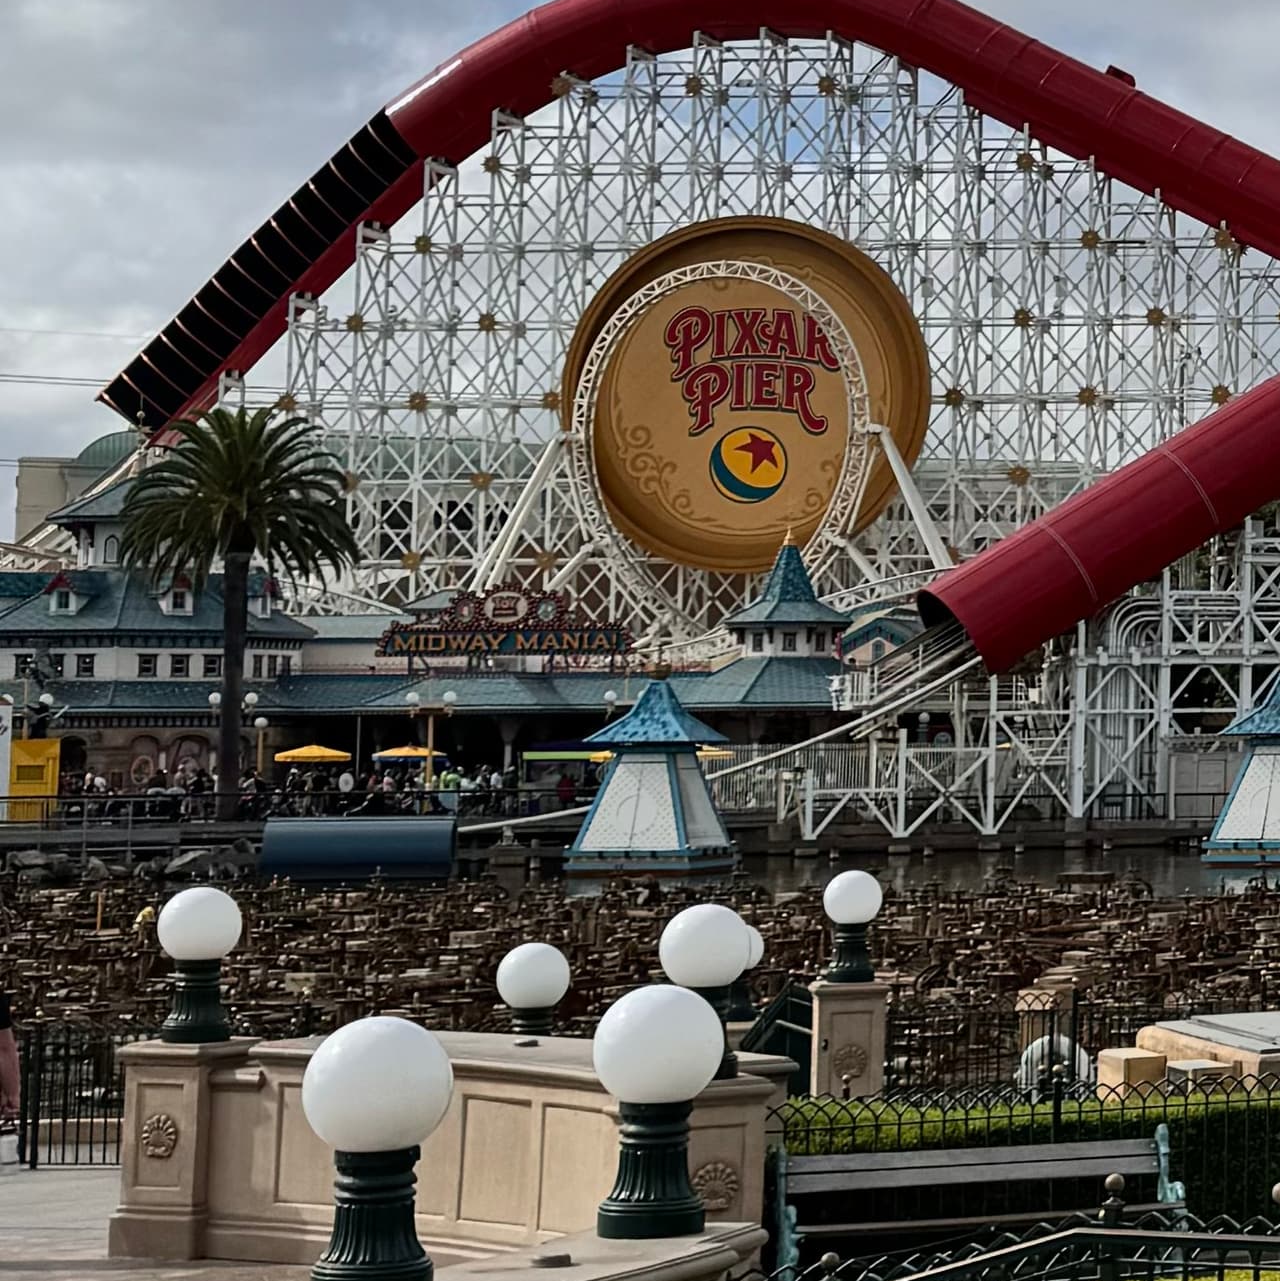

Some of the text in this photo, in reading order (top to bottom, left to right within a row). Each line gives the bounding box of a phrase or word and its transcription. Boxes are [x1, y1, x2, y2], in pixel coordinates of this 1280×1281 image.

[664, 306, 848, 379] PIXAR
[683, 360, 827, 435] PIER
[394, 632, 618, 651] MIDWAY MANIA!
